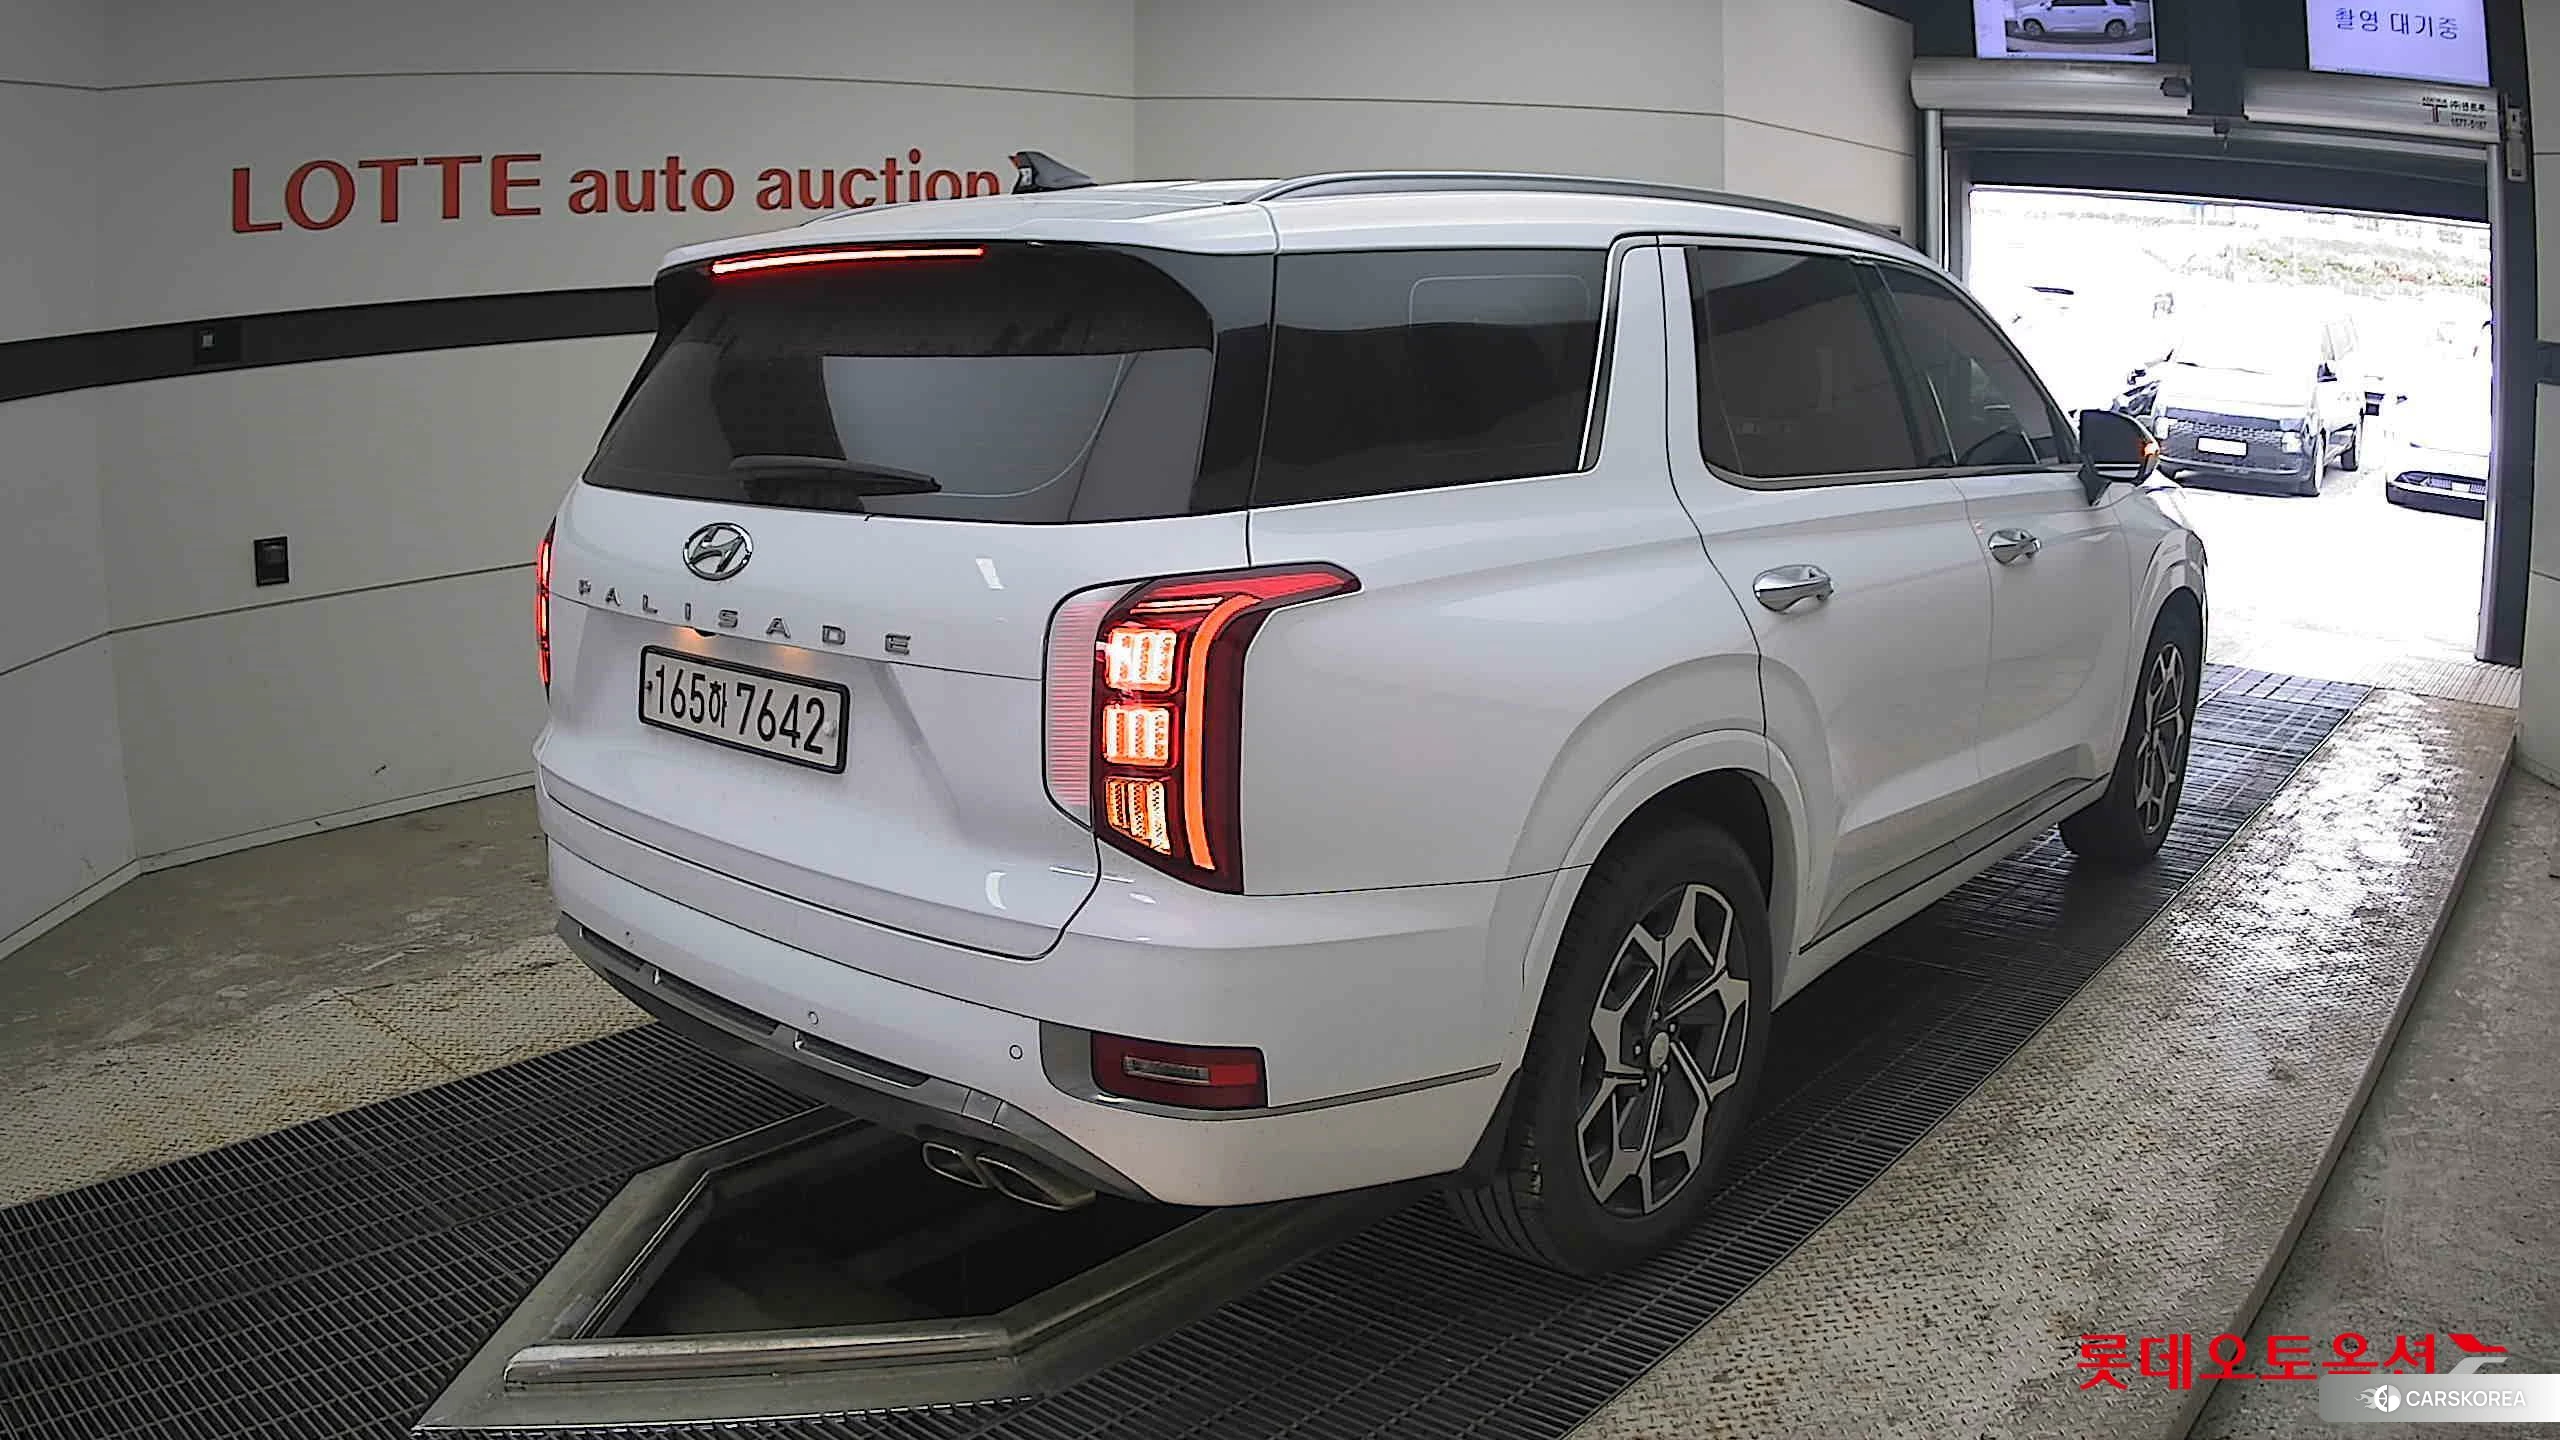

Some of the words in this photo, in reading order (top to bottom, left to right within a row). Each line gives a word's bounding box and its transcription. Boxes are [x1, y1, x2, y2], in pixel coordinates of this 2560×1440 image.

[2389, 12, 2458, 40] 대기중
[231, 153, 542, 234] LOTTE
[568, 155, 735, 213] auto
[756, 148, 1000, 211] auction
[578, 579, 912, 656] PALISADE
[655, 664, 728, 729] 165하
[736, 682, 825, 756] 7642
